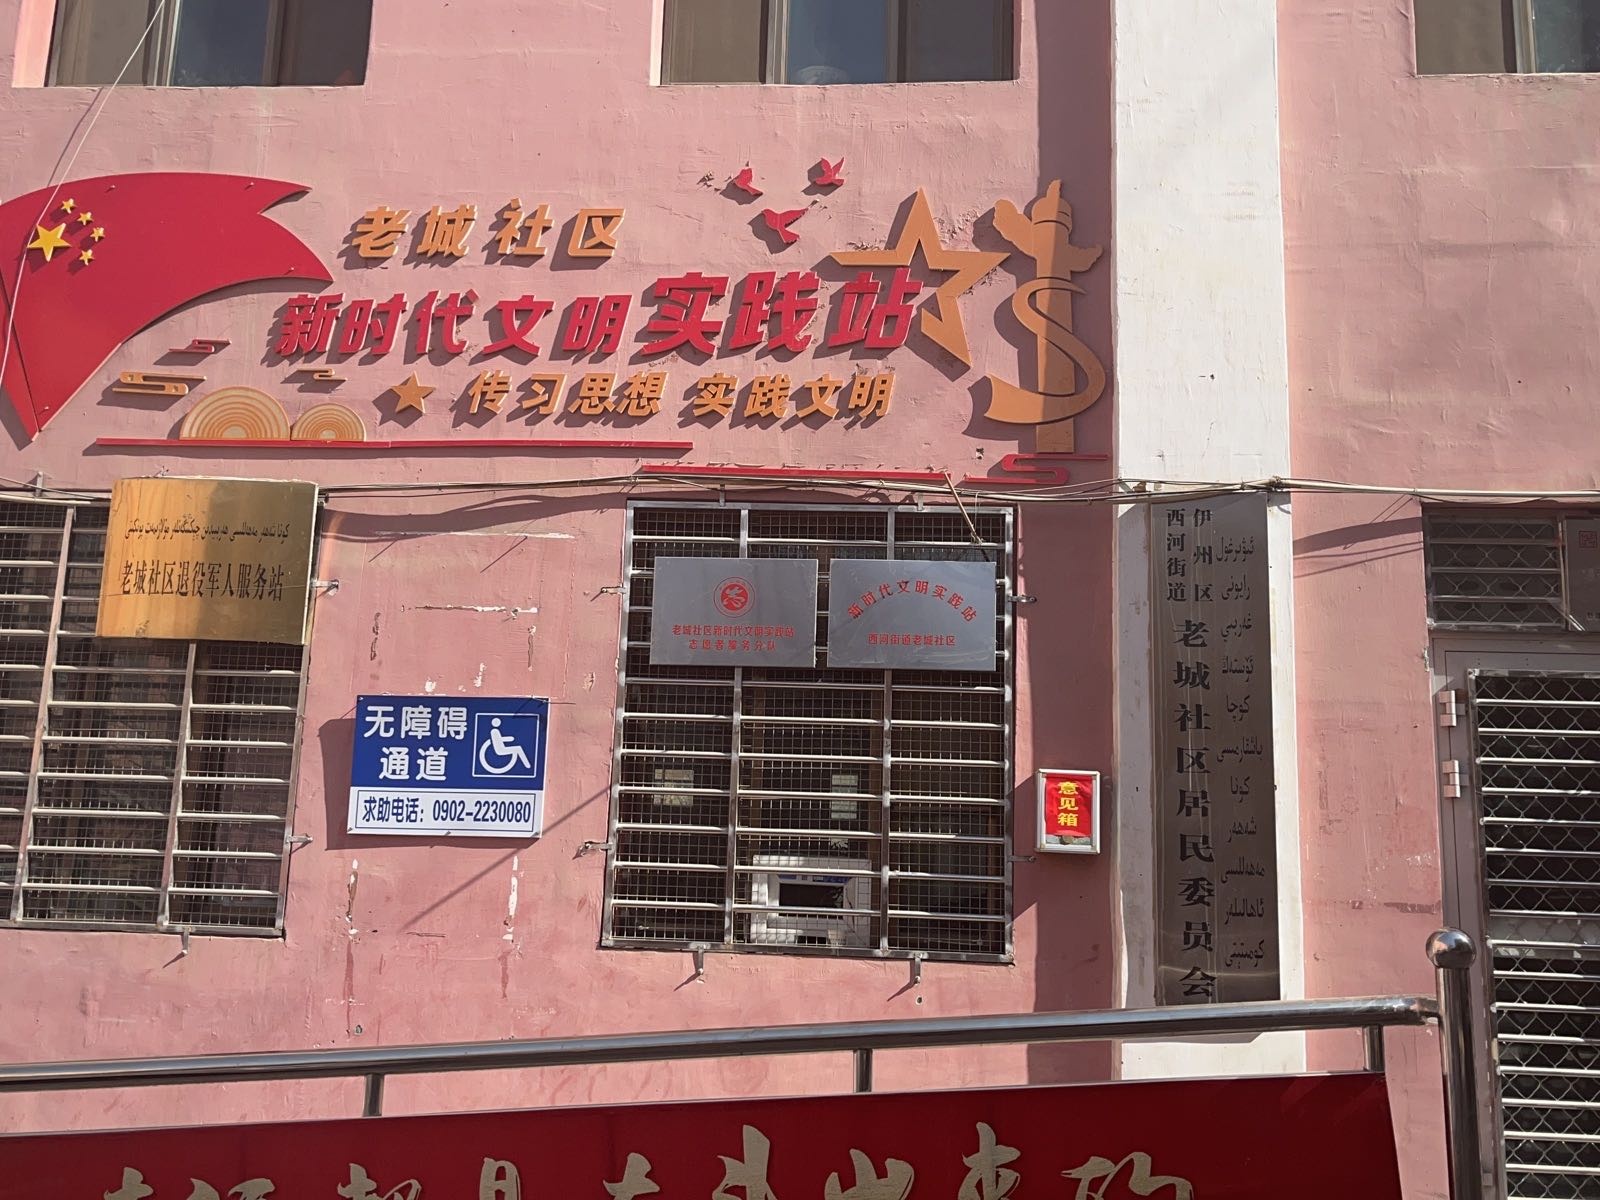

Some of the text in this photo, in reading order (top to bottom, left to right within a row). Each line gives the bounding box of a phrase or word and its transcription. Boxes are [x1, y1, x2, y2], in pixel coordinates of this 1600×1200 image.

[351, 198, 625, 258] 老城社区
[275, 269, 924, 357] 新时代文明实践站
[468, 370, 897, 420] 传习思想 实践文明
[1166, 508, 1187, 602] 西河街道
[1193, 508, 1214, 602] 伊州区
[120, 559, 285, 602] 老城社区退役军人服务站
[847, 579, 977, 622] 新时代文明实践站
[672, 624, 796, 638] 老城社区新时代文明实践站
[688, 639, 776, 652] 志愿者服务分队
[867, 632, 957, 647] 西河街道老城社区
[363, 705, 468, 740] 无障碍
[378, 746, 449, 781] 通道
[1057, 781, 1079, 827] 意见箱
[1173, 619, 1217, 997] 老城社区居民委员会
